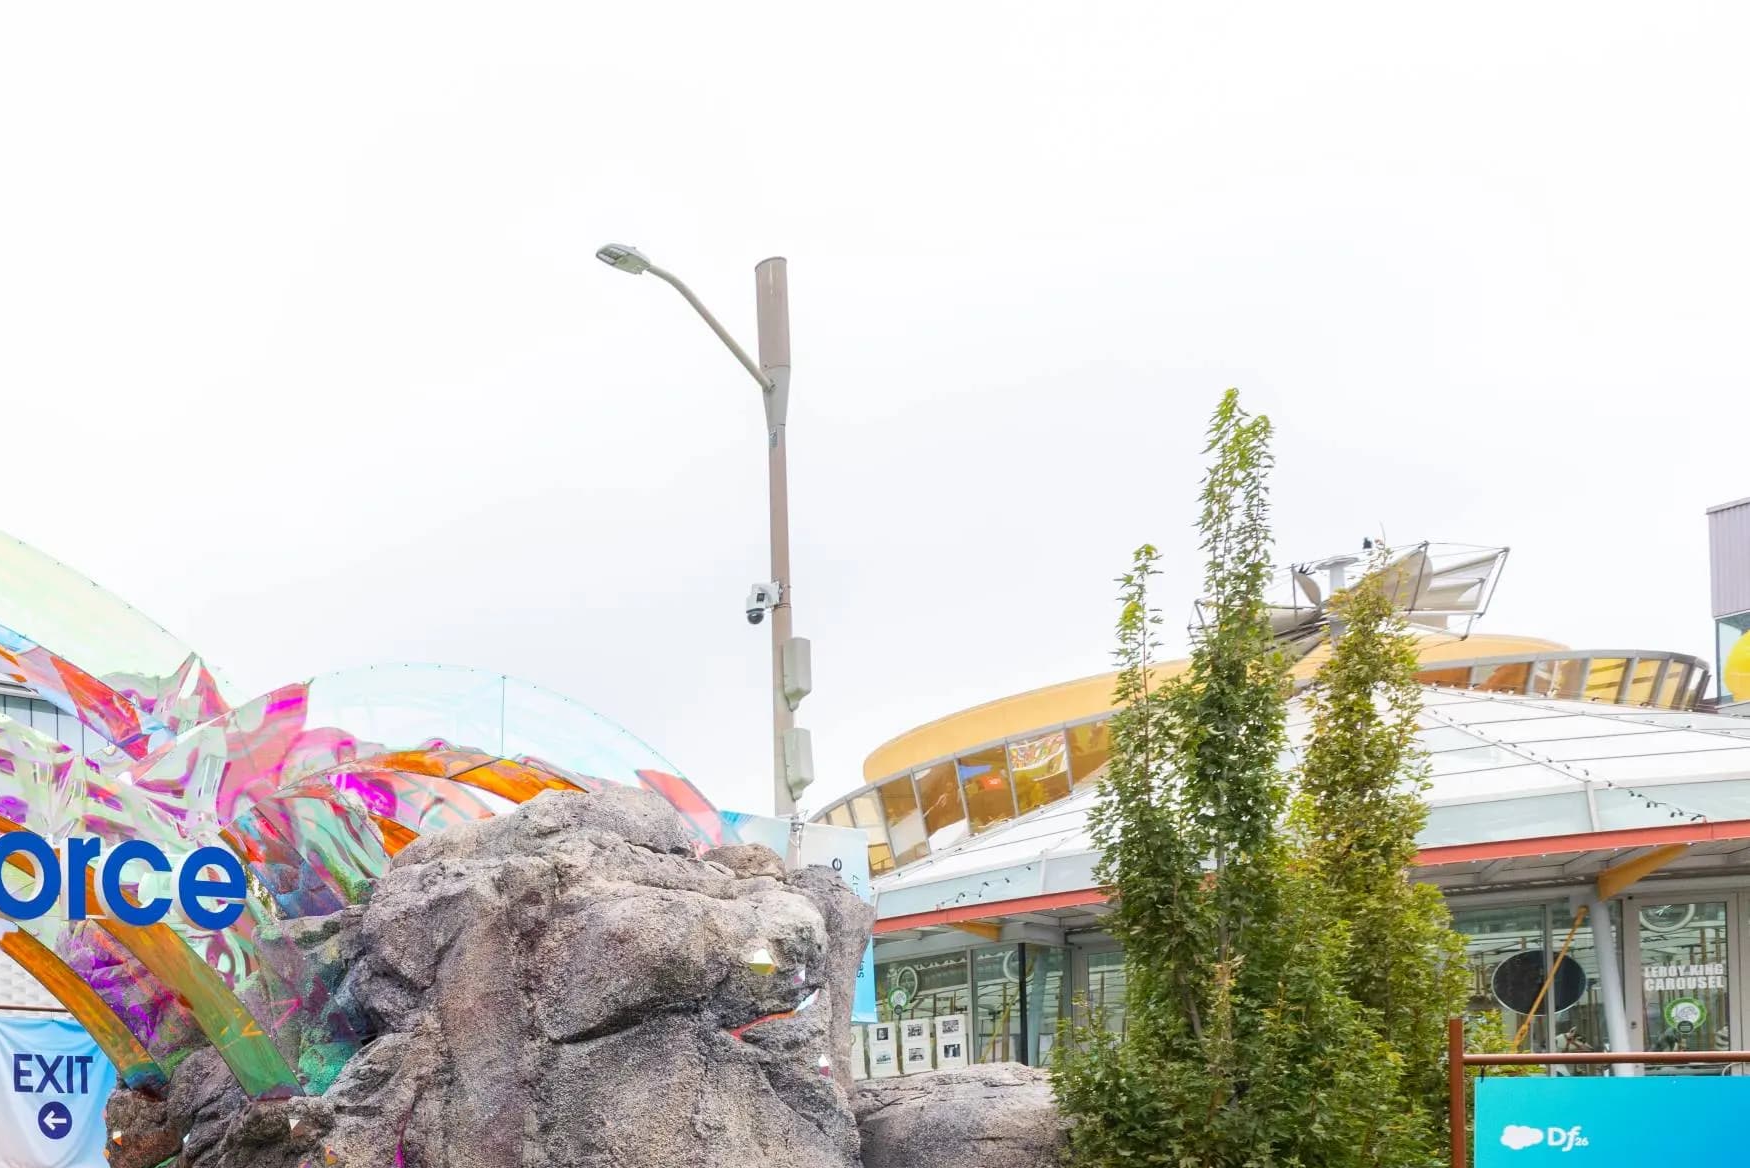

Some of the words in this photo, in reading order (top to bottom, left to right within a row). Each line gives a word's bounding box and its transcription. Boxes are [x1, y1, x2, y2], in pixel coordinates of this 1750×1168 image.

[1644, 965, 1687, 978] LEROY
[1689, 963, 1724, 976] KING
[1644, 975, 1725, 991] CAROUSEL
[13, 1053, 94, 1094] EXIT
